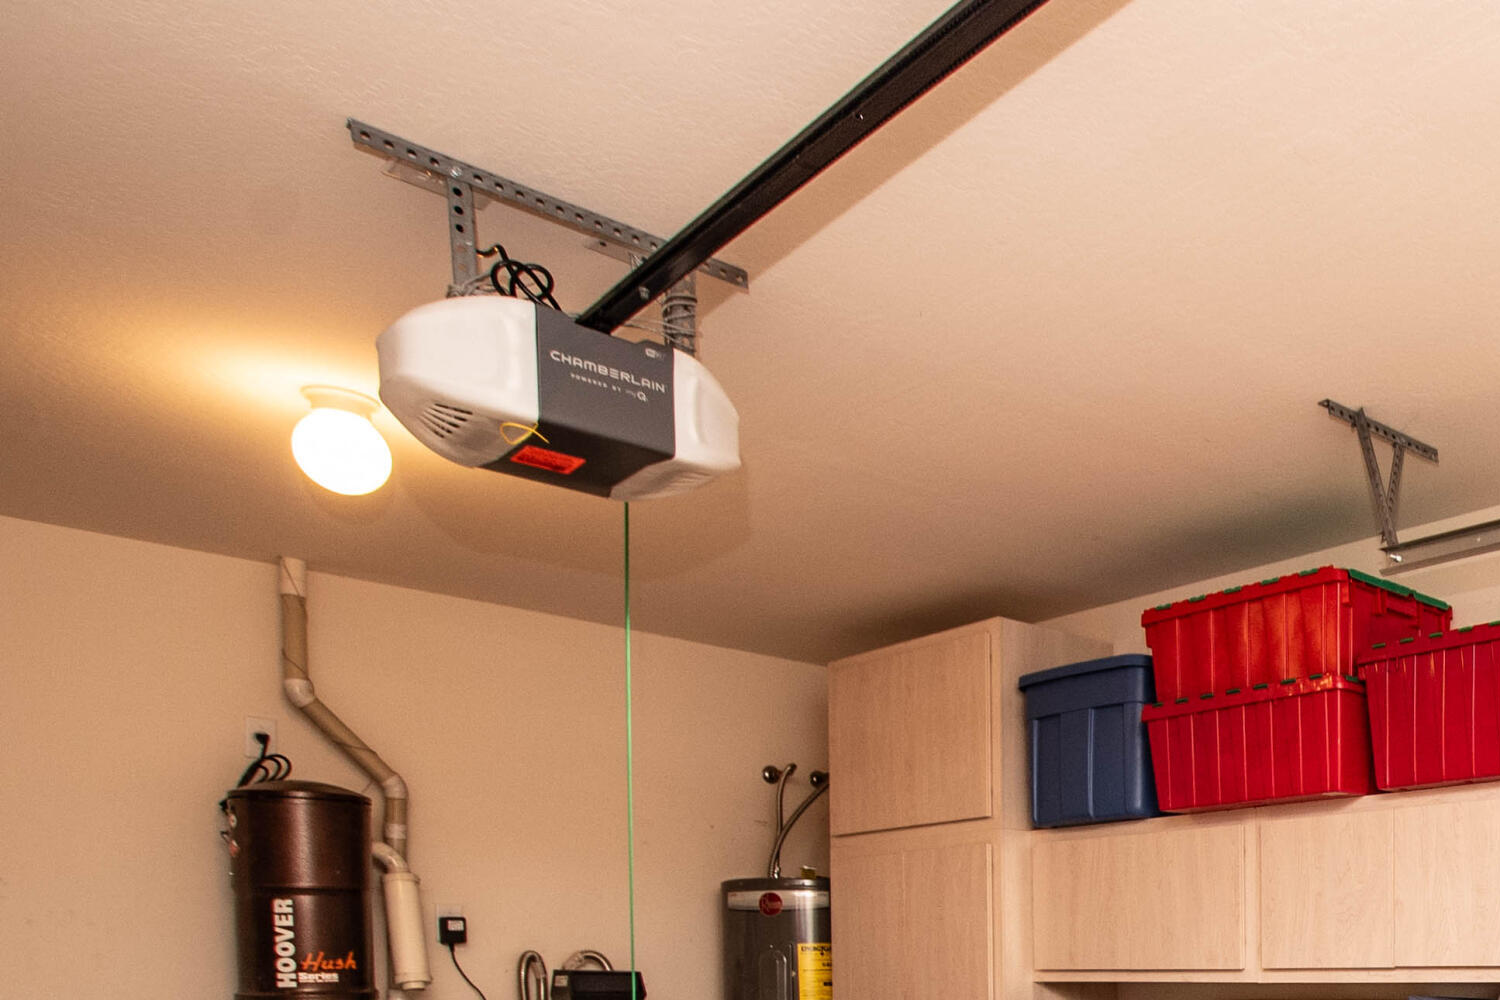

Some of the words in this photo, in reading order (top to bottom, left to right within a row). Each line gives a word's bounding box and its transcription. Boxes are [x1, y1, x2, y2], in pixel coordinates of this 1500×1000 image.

[550, 350, 666, 393] CHAMBERLAIN
[273, 898, 298, 988] HOOVER
[298, 972, 339, 981] Series
[302, 951, 357, 972] Hush
